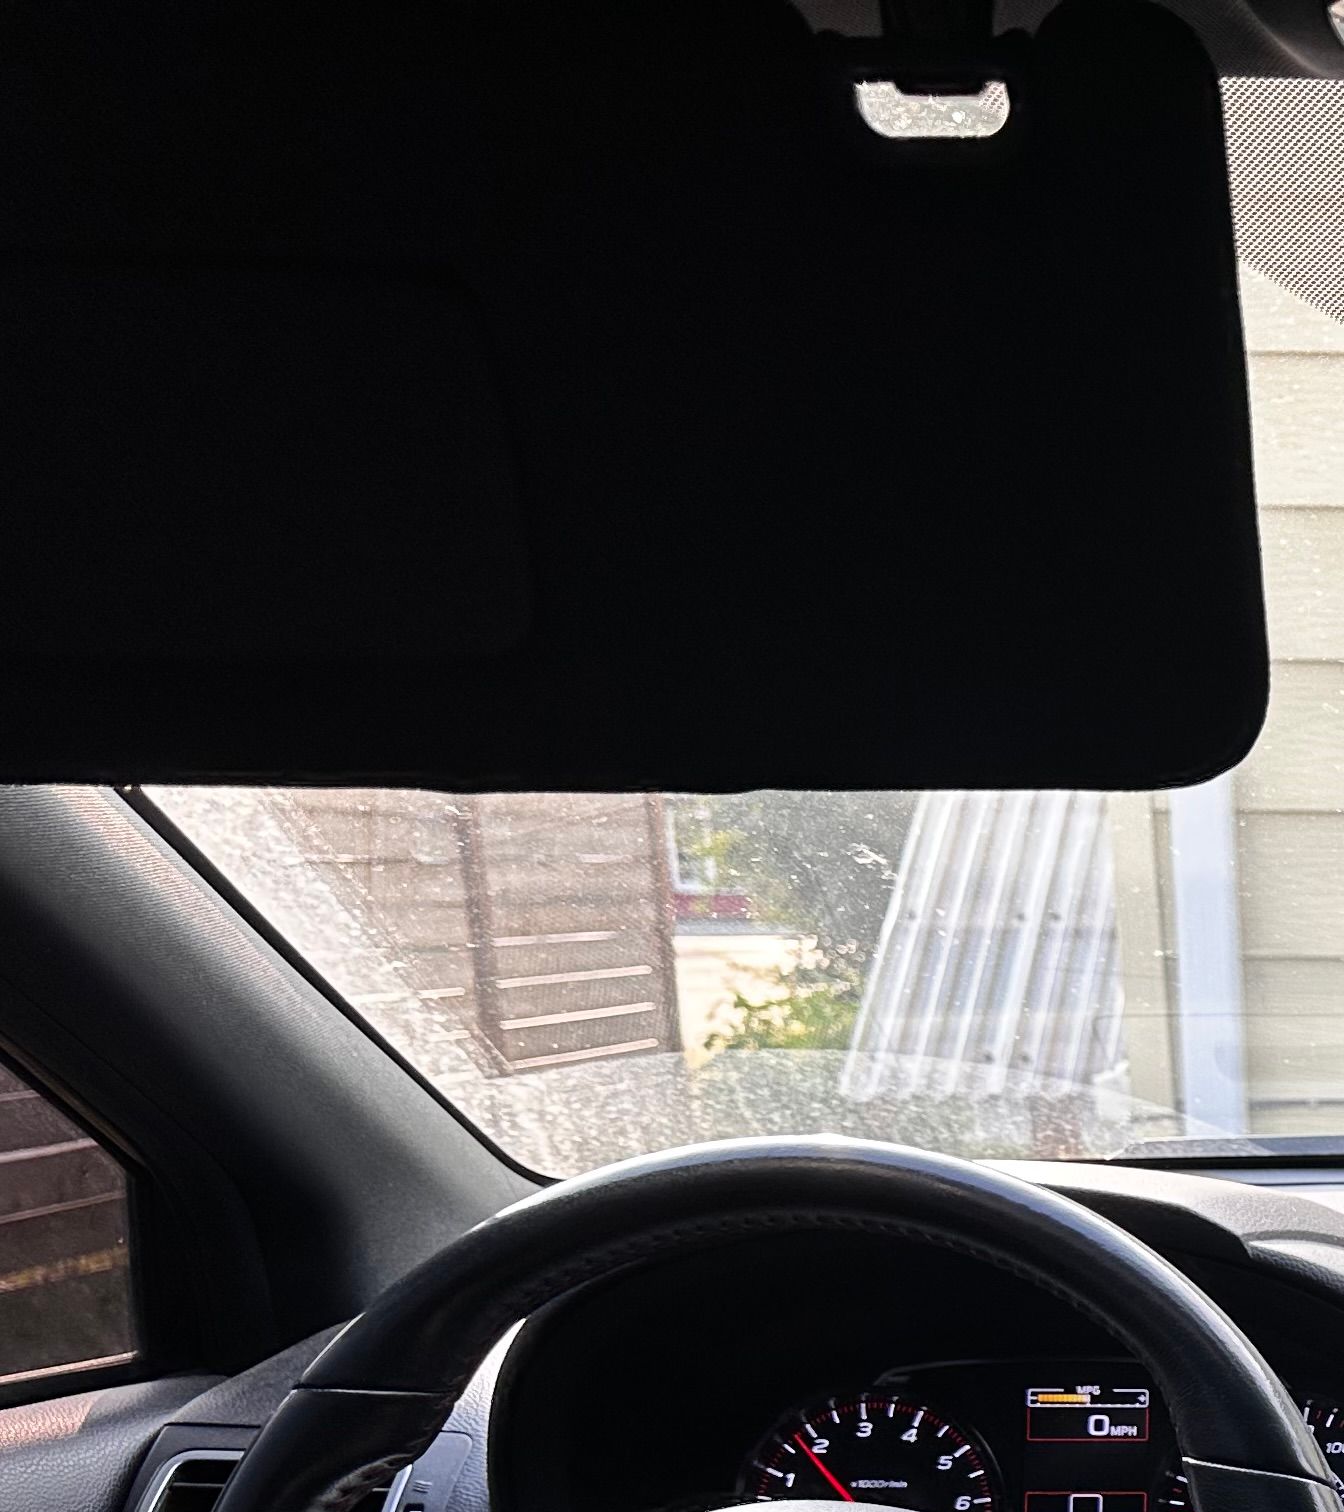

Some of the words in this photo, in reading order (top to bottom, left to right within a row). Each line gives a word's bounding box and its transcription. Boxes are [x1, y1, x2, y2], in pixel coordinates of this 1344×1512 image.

[1076, 1385, 1101, 1395] MPG
[856, 1422, 873, 1438] 3
[1087, 1415, 1110, 1436] 0
[1110, 1426, 1137, 1436] MPH
[901, 1428, 918, 1443] 4
[811, 1439, 830, 1454] 2
[936, 1455, 953, 1470] 5
[785, 1473, 796, 1488] 1
[954, 1496, 972, 1511] 6
